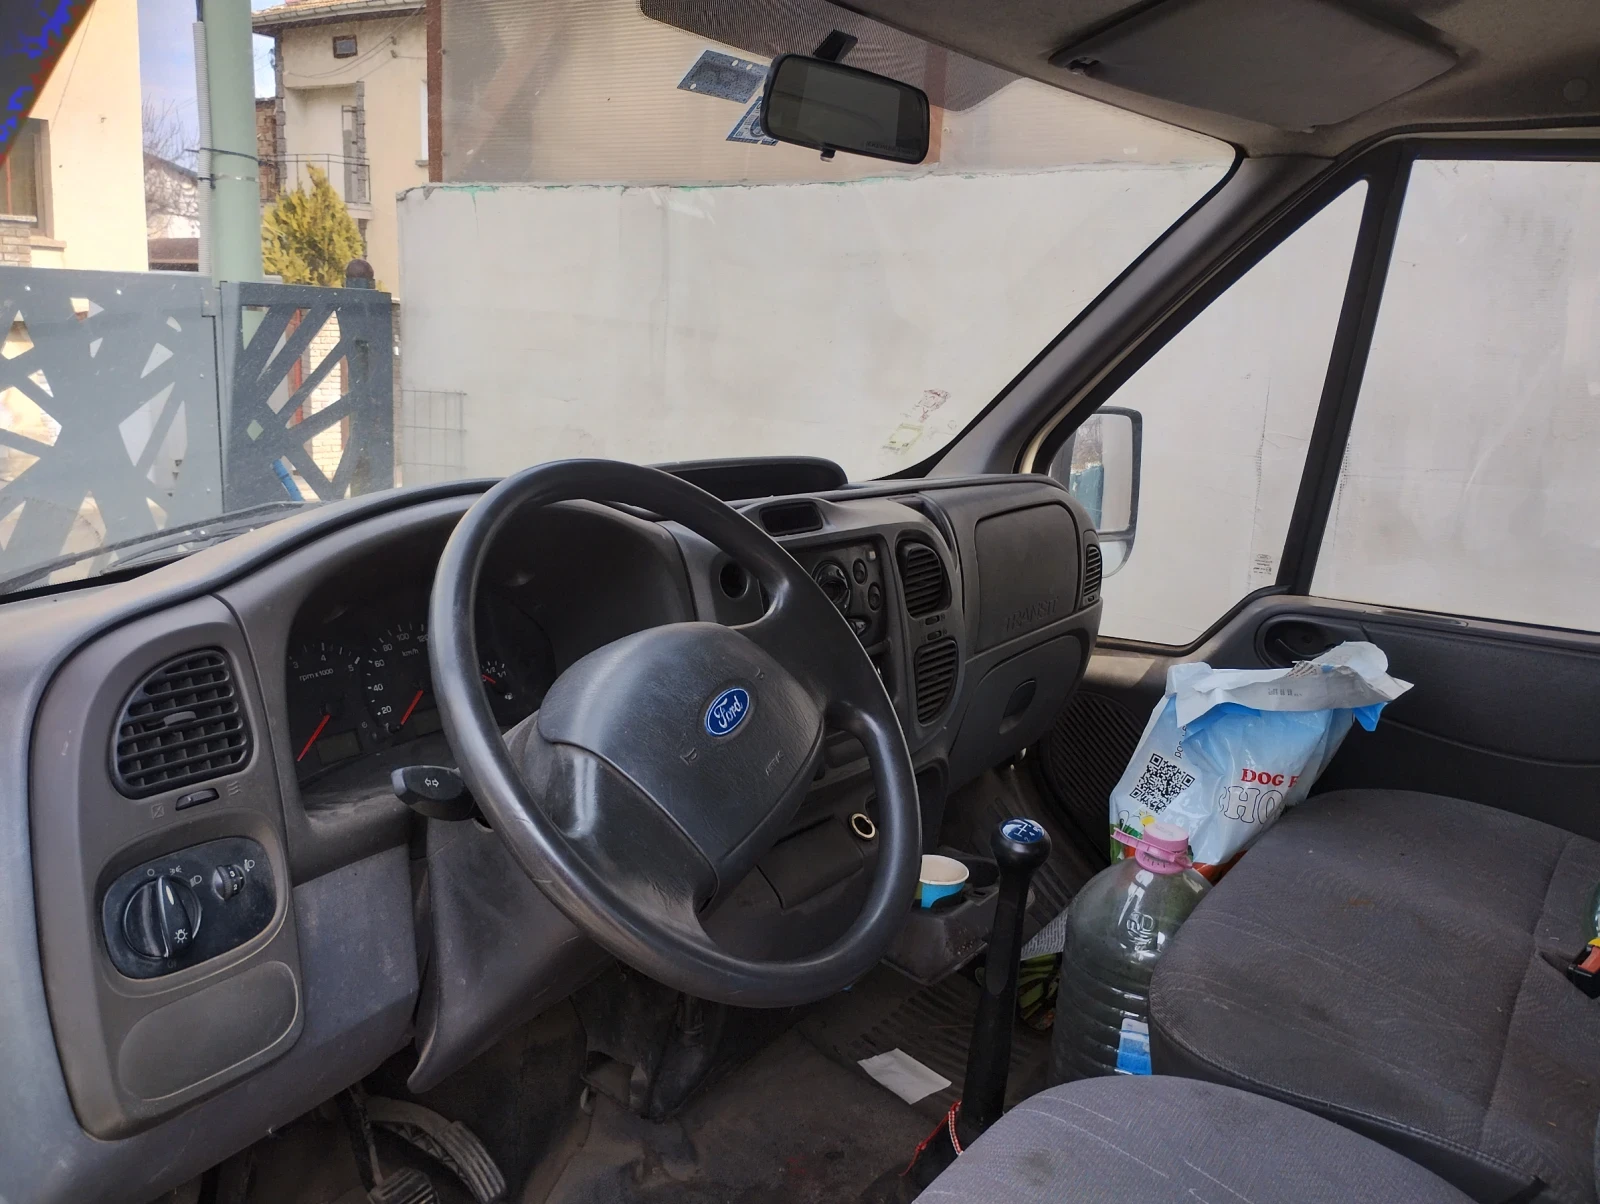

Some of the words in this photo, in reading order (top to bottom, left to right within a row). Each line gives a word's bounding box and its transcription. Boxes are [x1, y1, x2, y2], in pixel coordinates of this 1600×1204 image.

[396, 633, 409, 641] 100
[382, 643, 393, 652] 80
[293, 661, 299, 669] 3
[348, 664, 354, 672] 5
[374, 659, 385, 668] 60
[299, 673, 315, 681] rpm
[319, 668, 334, 677] 1000
[373, 683, 384, 692] 40
[381, 705, 392, 715] 20
[713, 695, 744, 729] Ford
[1240, 768, 1285, 787] DOG
[1288, 775, 1300, 788] F
